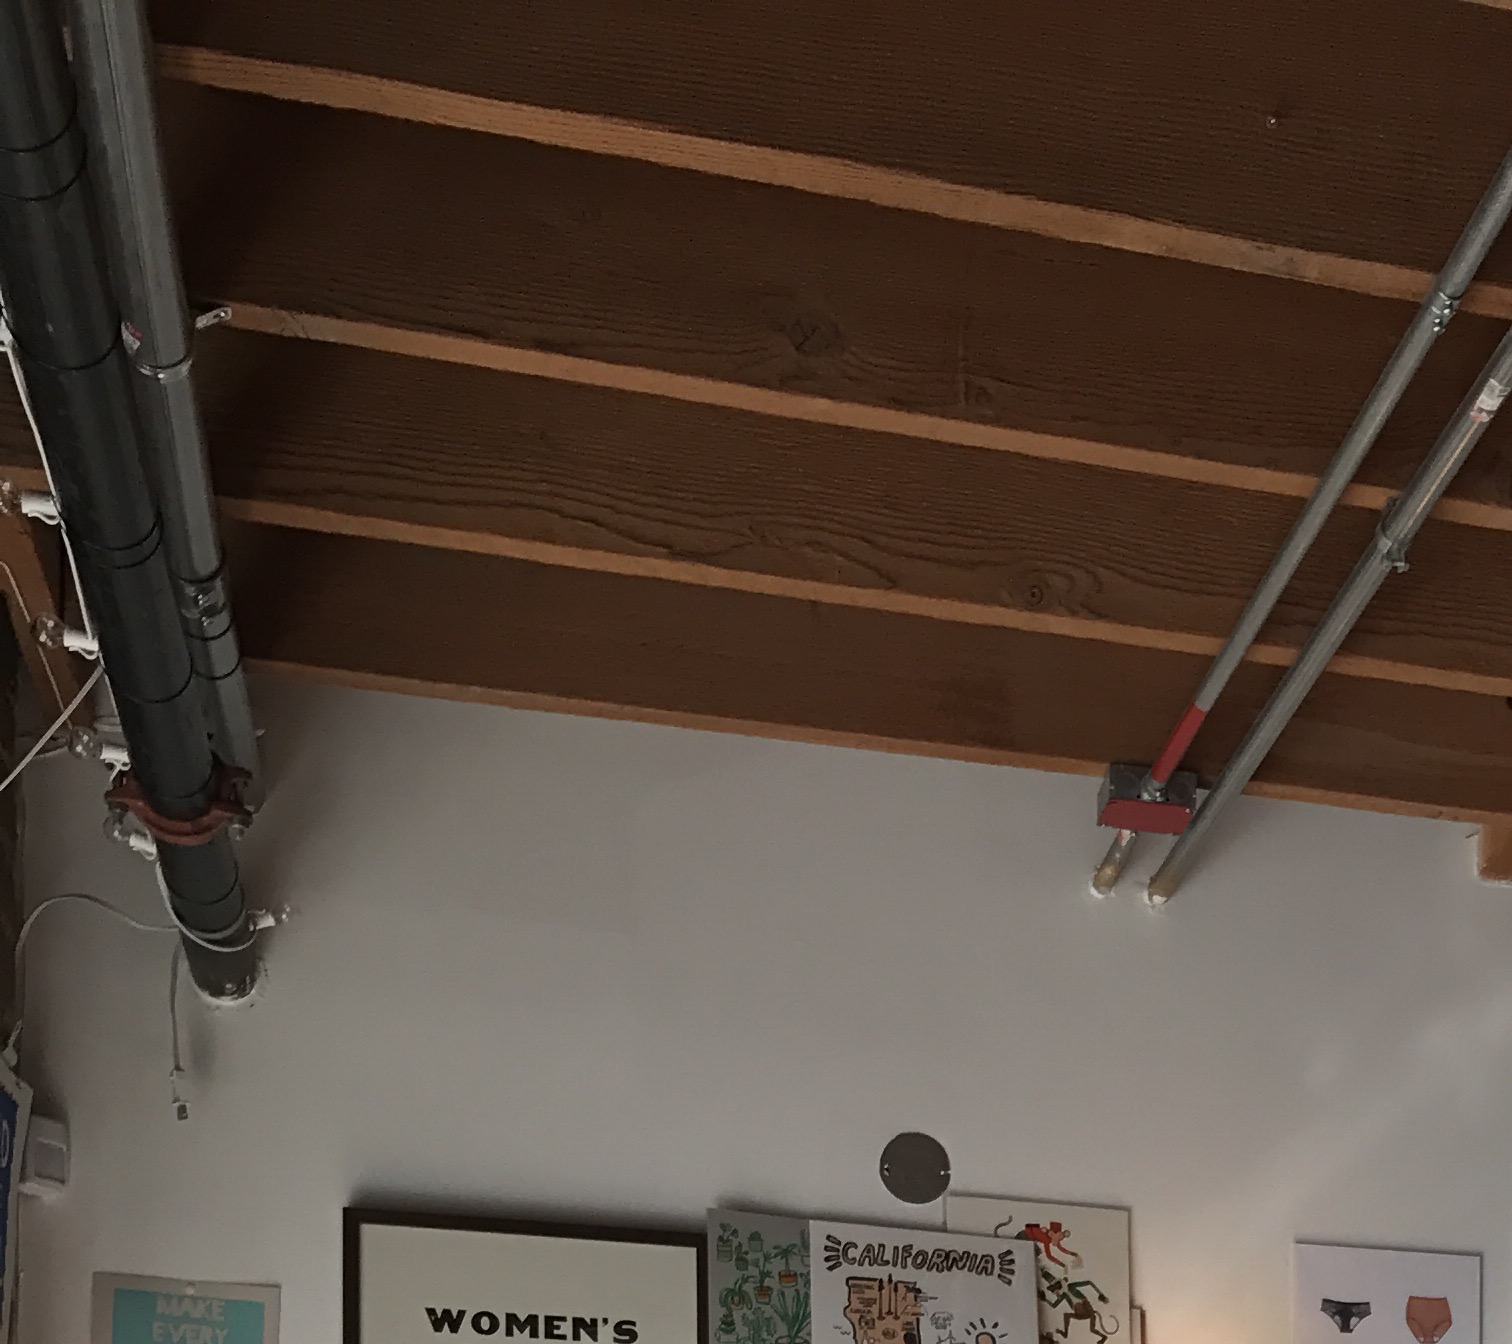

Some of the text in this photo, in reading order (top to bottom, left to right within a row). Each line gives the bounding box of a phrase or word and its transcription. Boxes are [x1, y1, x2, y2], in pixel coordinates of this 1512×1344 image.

[841, 1243, 995, 1277] CALIFORNIA
[155, 1296, 225, 1321] MAKE
[424, 1306, 639, 1344] WOMEN'S
